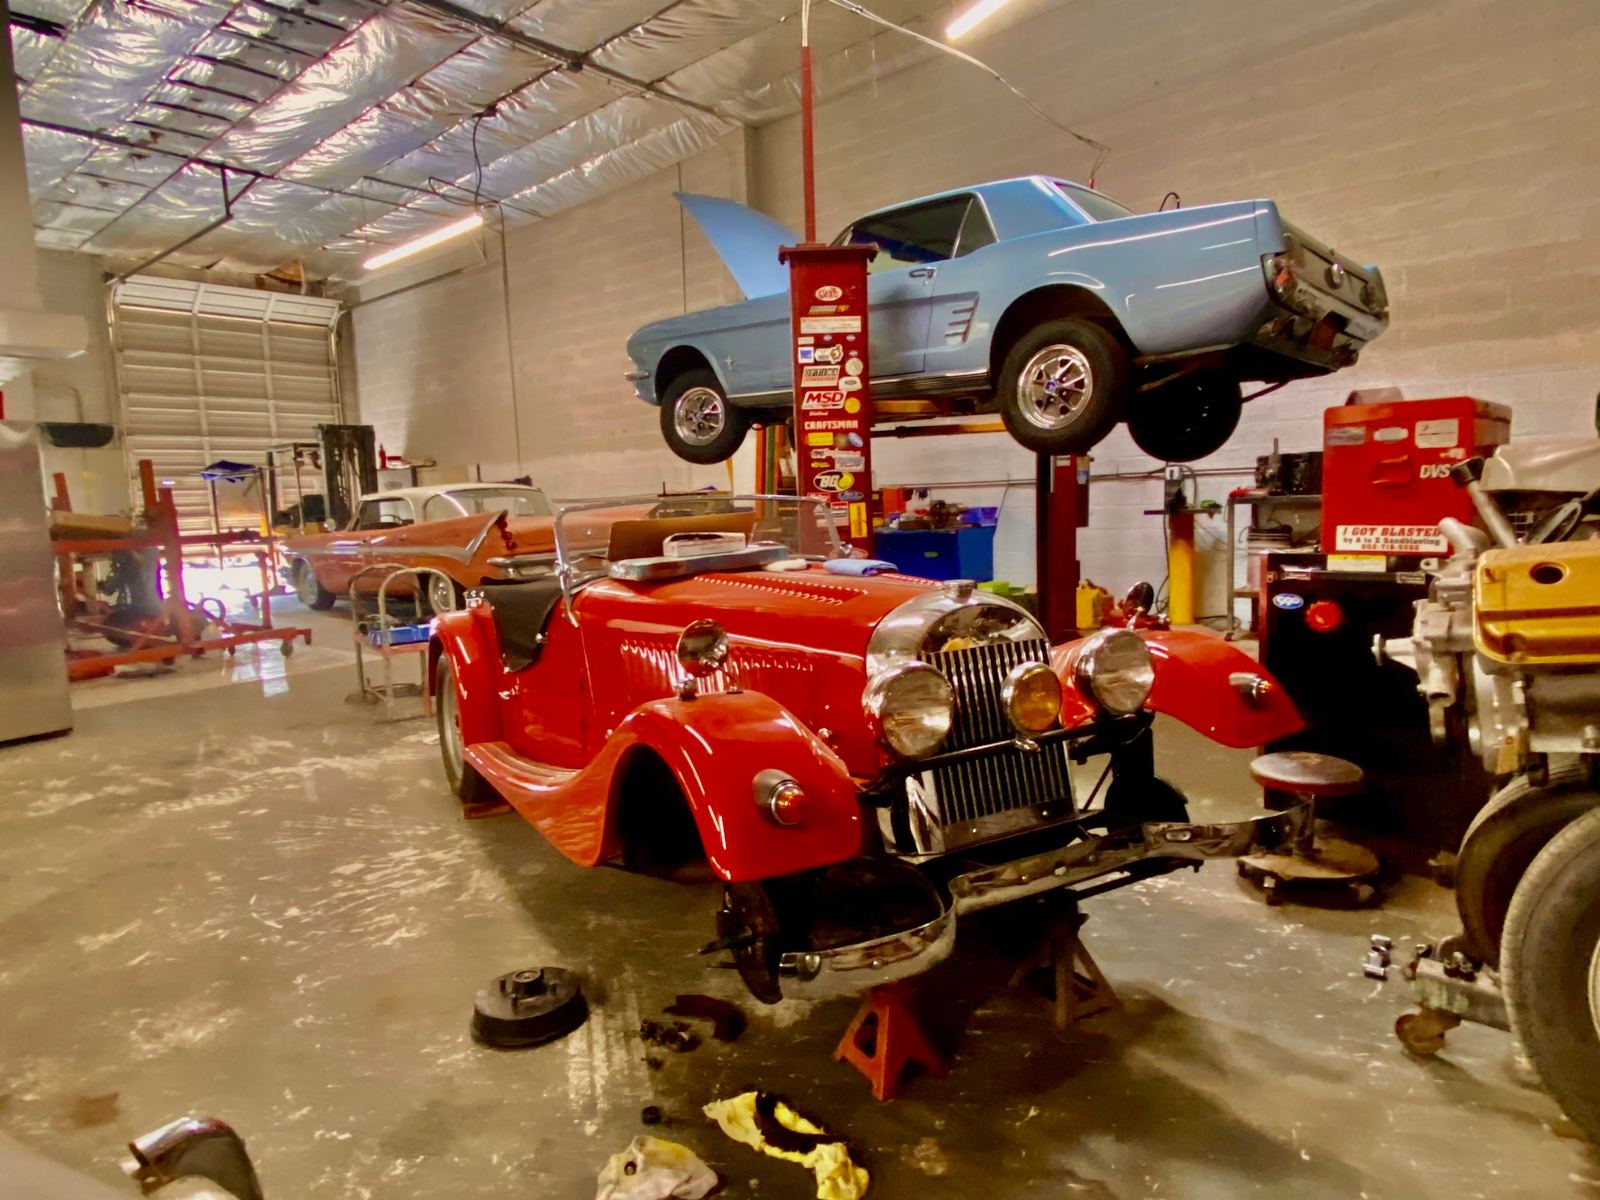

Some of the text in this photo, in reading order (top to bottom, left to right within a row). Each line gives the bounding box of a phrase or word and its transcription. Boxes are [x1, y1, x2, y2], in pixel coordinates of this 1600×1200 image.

[806, 392, 844, 403] MSD
[804, 419, 859, 431] CRAFTSMAN
[819, 474, 840, 488] BG
[1343, 527, 1443, 537] I GOT BLASTED
